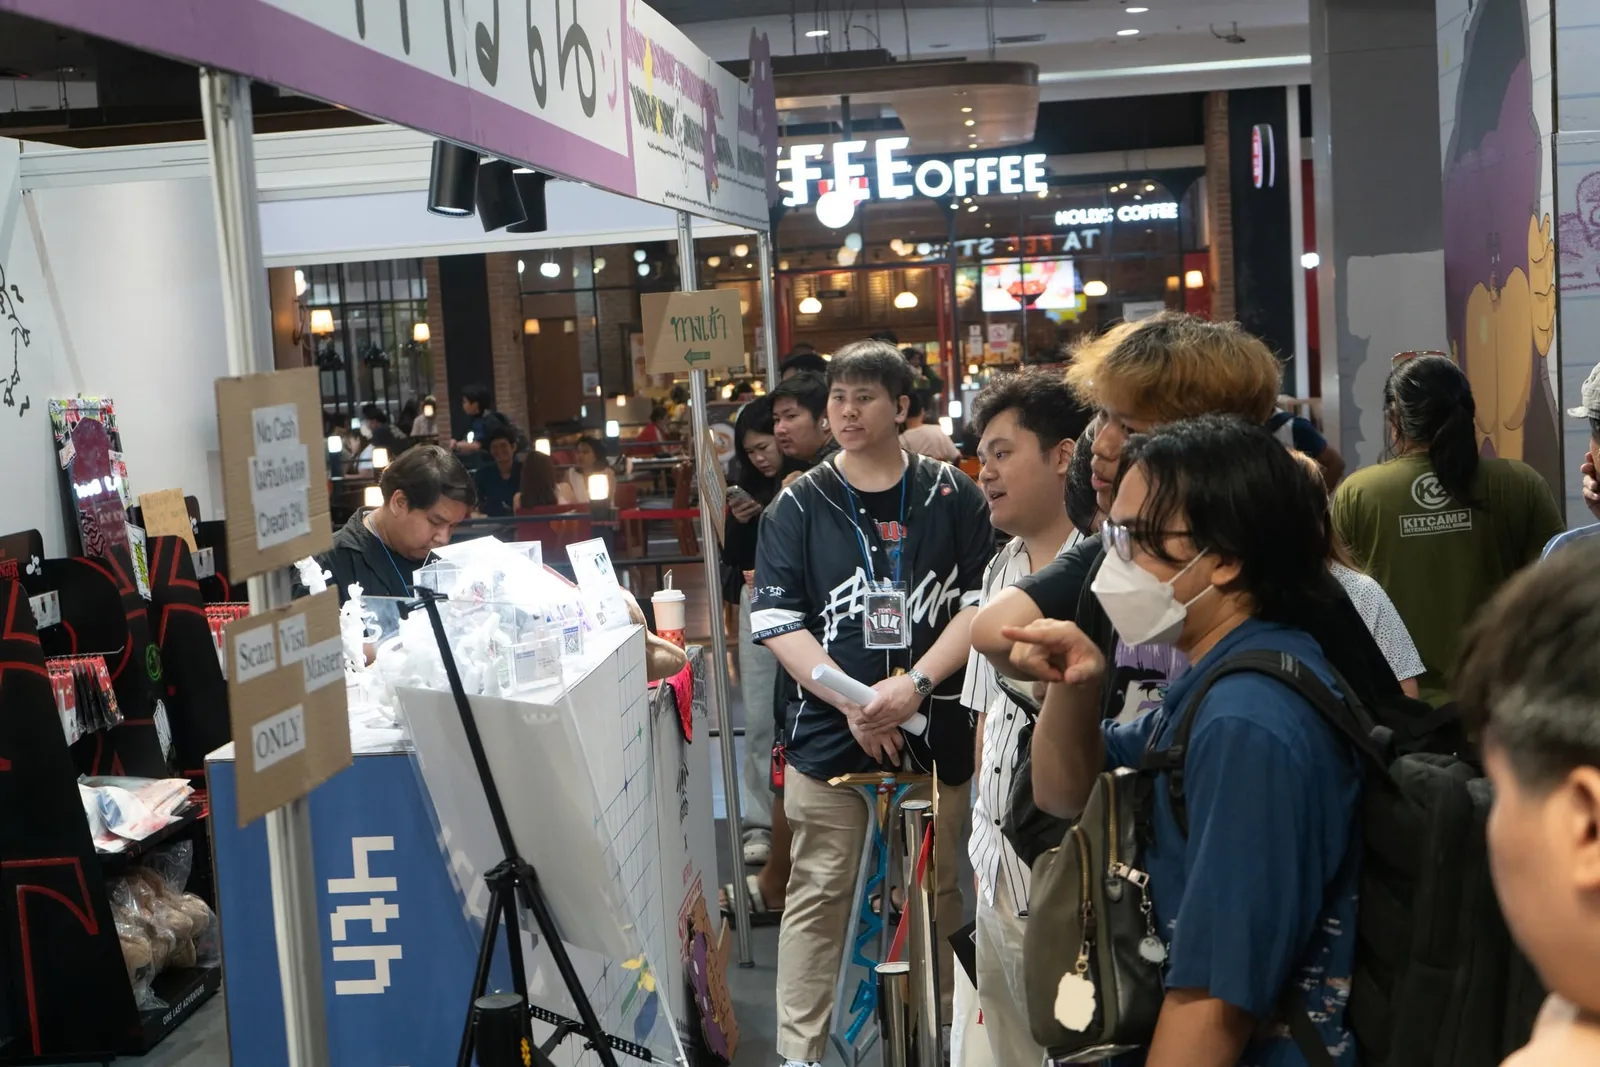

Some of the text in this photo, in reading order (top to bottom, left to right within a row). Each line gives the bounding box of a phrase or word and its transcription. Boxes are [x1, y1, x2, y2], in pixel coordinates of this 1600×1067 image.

[1117, 202, 1178, 222] COFFEE
[670, 306, 727, 342] ทางเข้า
[256, 415, 297, 444] No Cash
[259, 507, 288, 538] Credit
[1403, 512, 1468, 529] KITCAMP
[1404, 523, 1453, 534] INTERNATIONAL
[868, 612, 900, 630] YUK
[239, 641, 275, 671] Scan
[305, 651, 342, 682] Master
[256, 714, 301, 759] ONLY
[163, 984, 204, 1025] ONE LAST ADVENTURE
